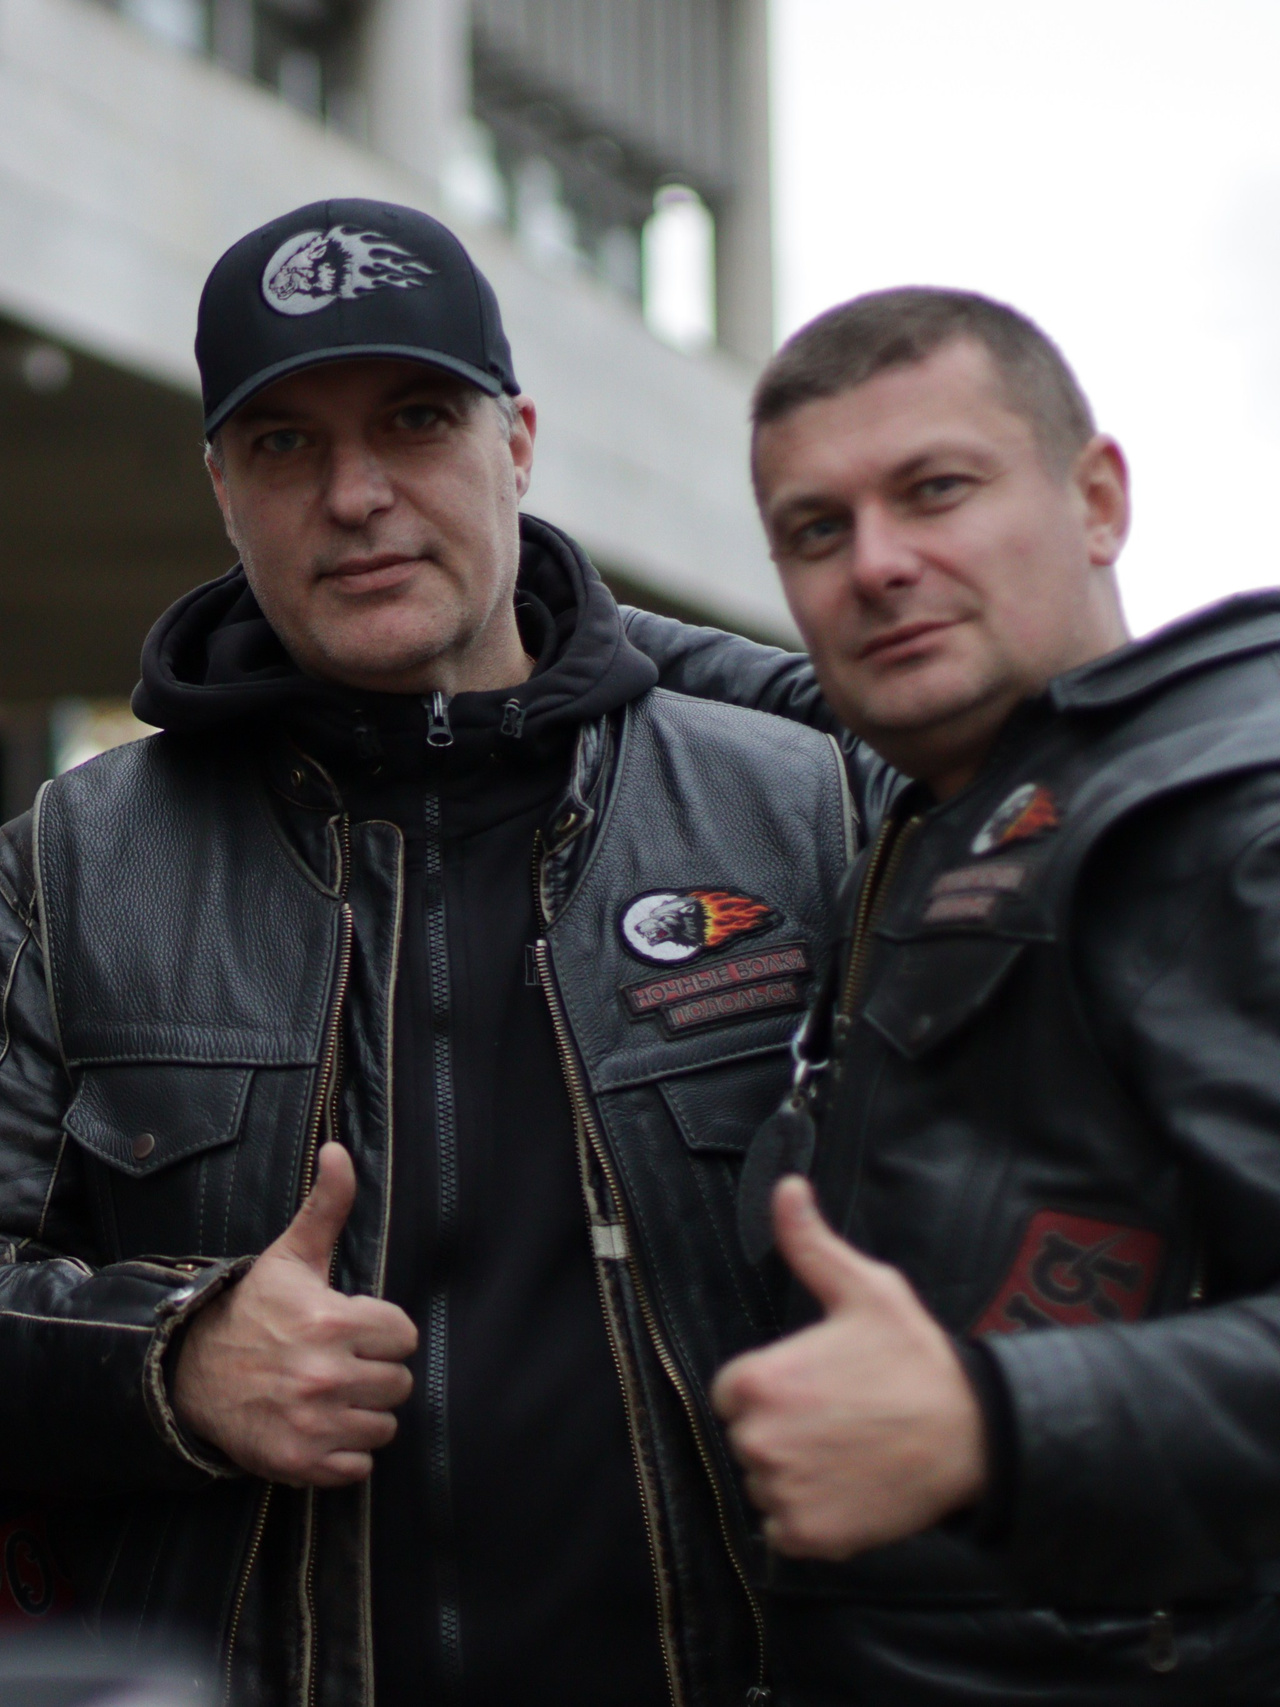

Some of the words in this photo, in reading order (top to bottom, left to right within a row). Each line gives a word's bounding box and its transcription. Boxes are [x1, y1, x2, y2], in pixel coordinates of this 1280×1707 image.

[633, 966, 733, 1009] НОЧНЫЕ
[735, 949, 807, 983] ВОЛКИ
[671, 982, 798, 1026] ПОДОЛЬСК
